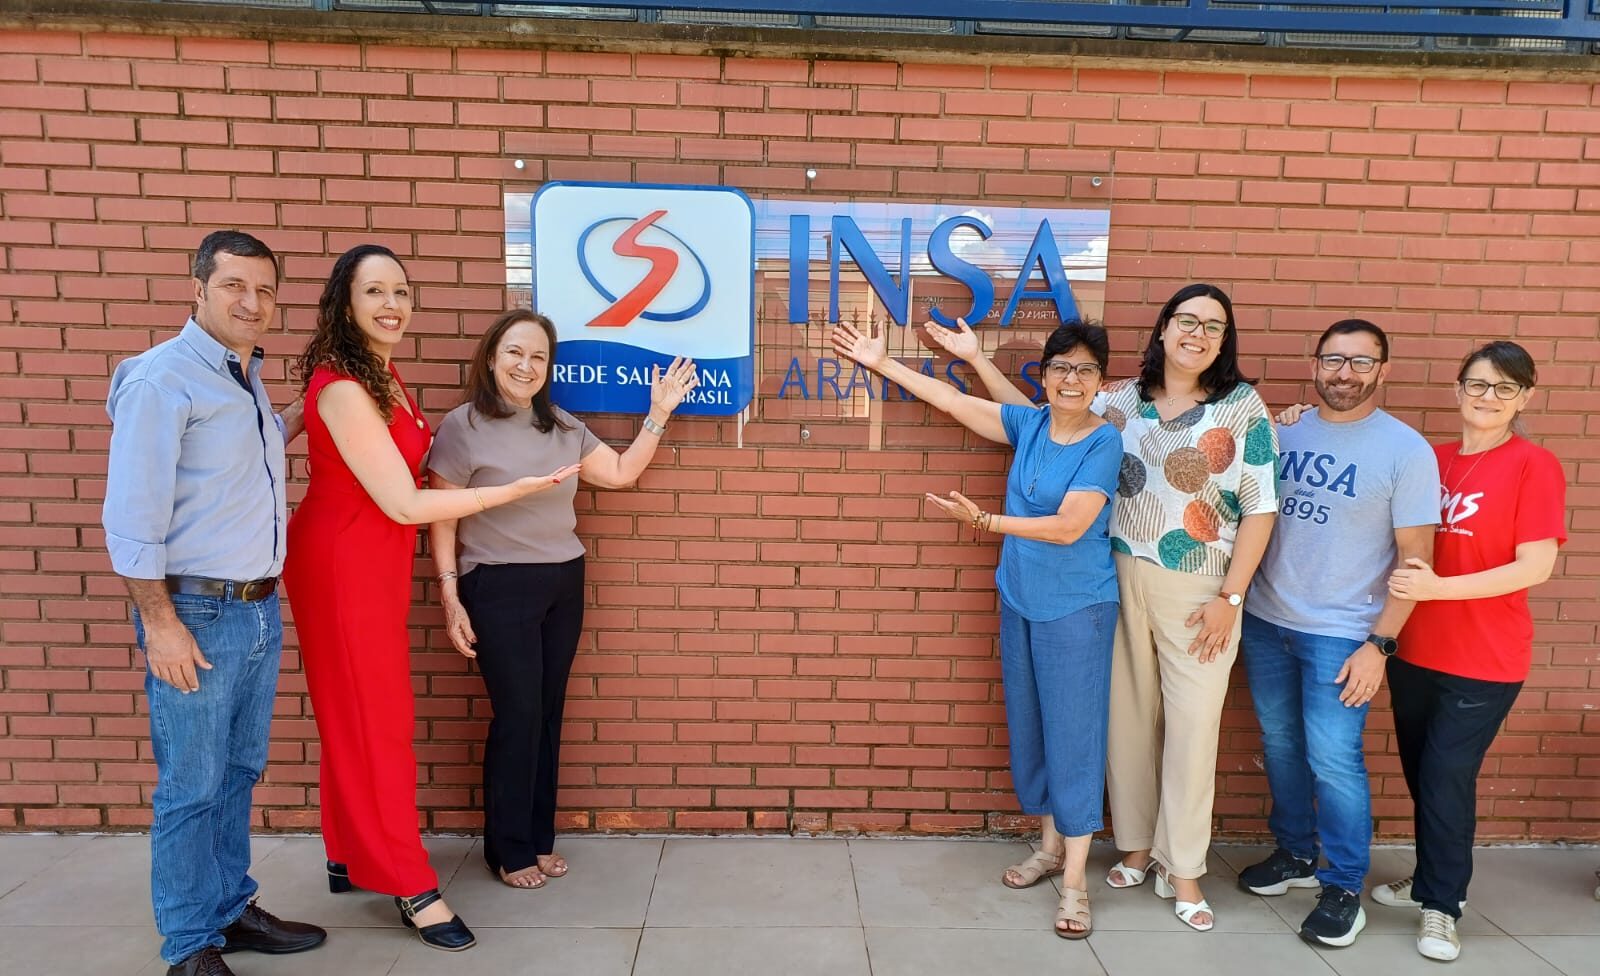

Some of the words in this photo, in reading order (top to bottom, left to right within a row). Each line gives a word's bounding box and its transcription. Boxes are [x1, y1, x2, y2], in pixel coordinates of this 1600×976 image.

[789, 214, 1080, 327] INSA
[553, 364, 608, 384] REDE
[1280, 450, 1358, 498] NSA
[1280, 496, 1331, 525] 895
